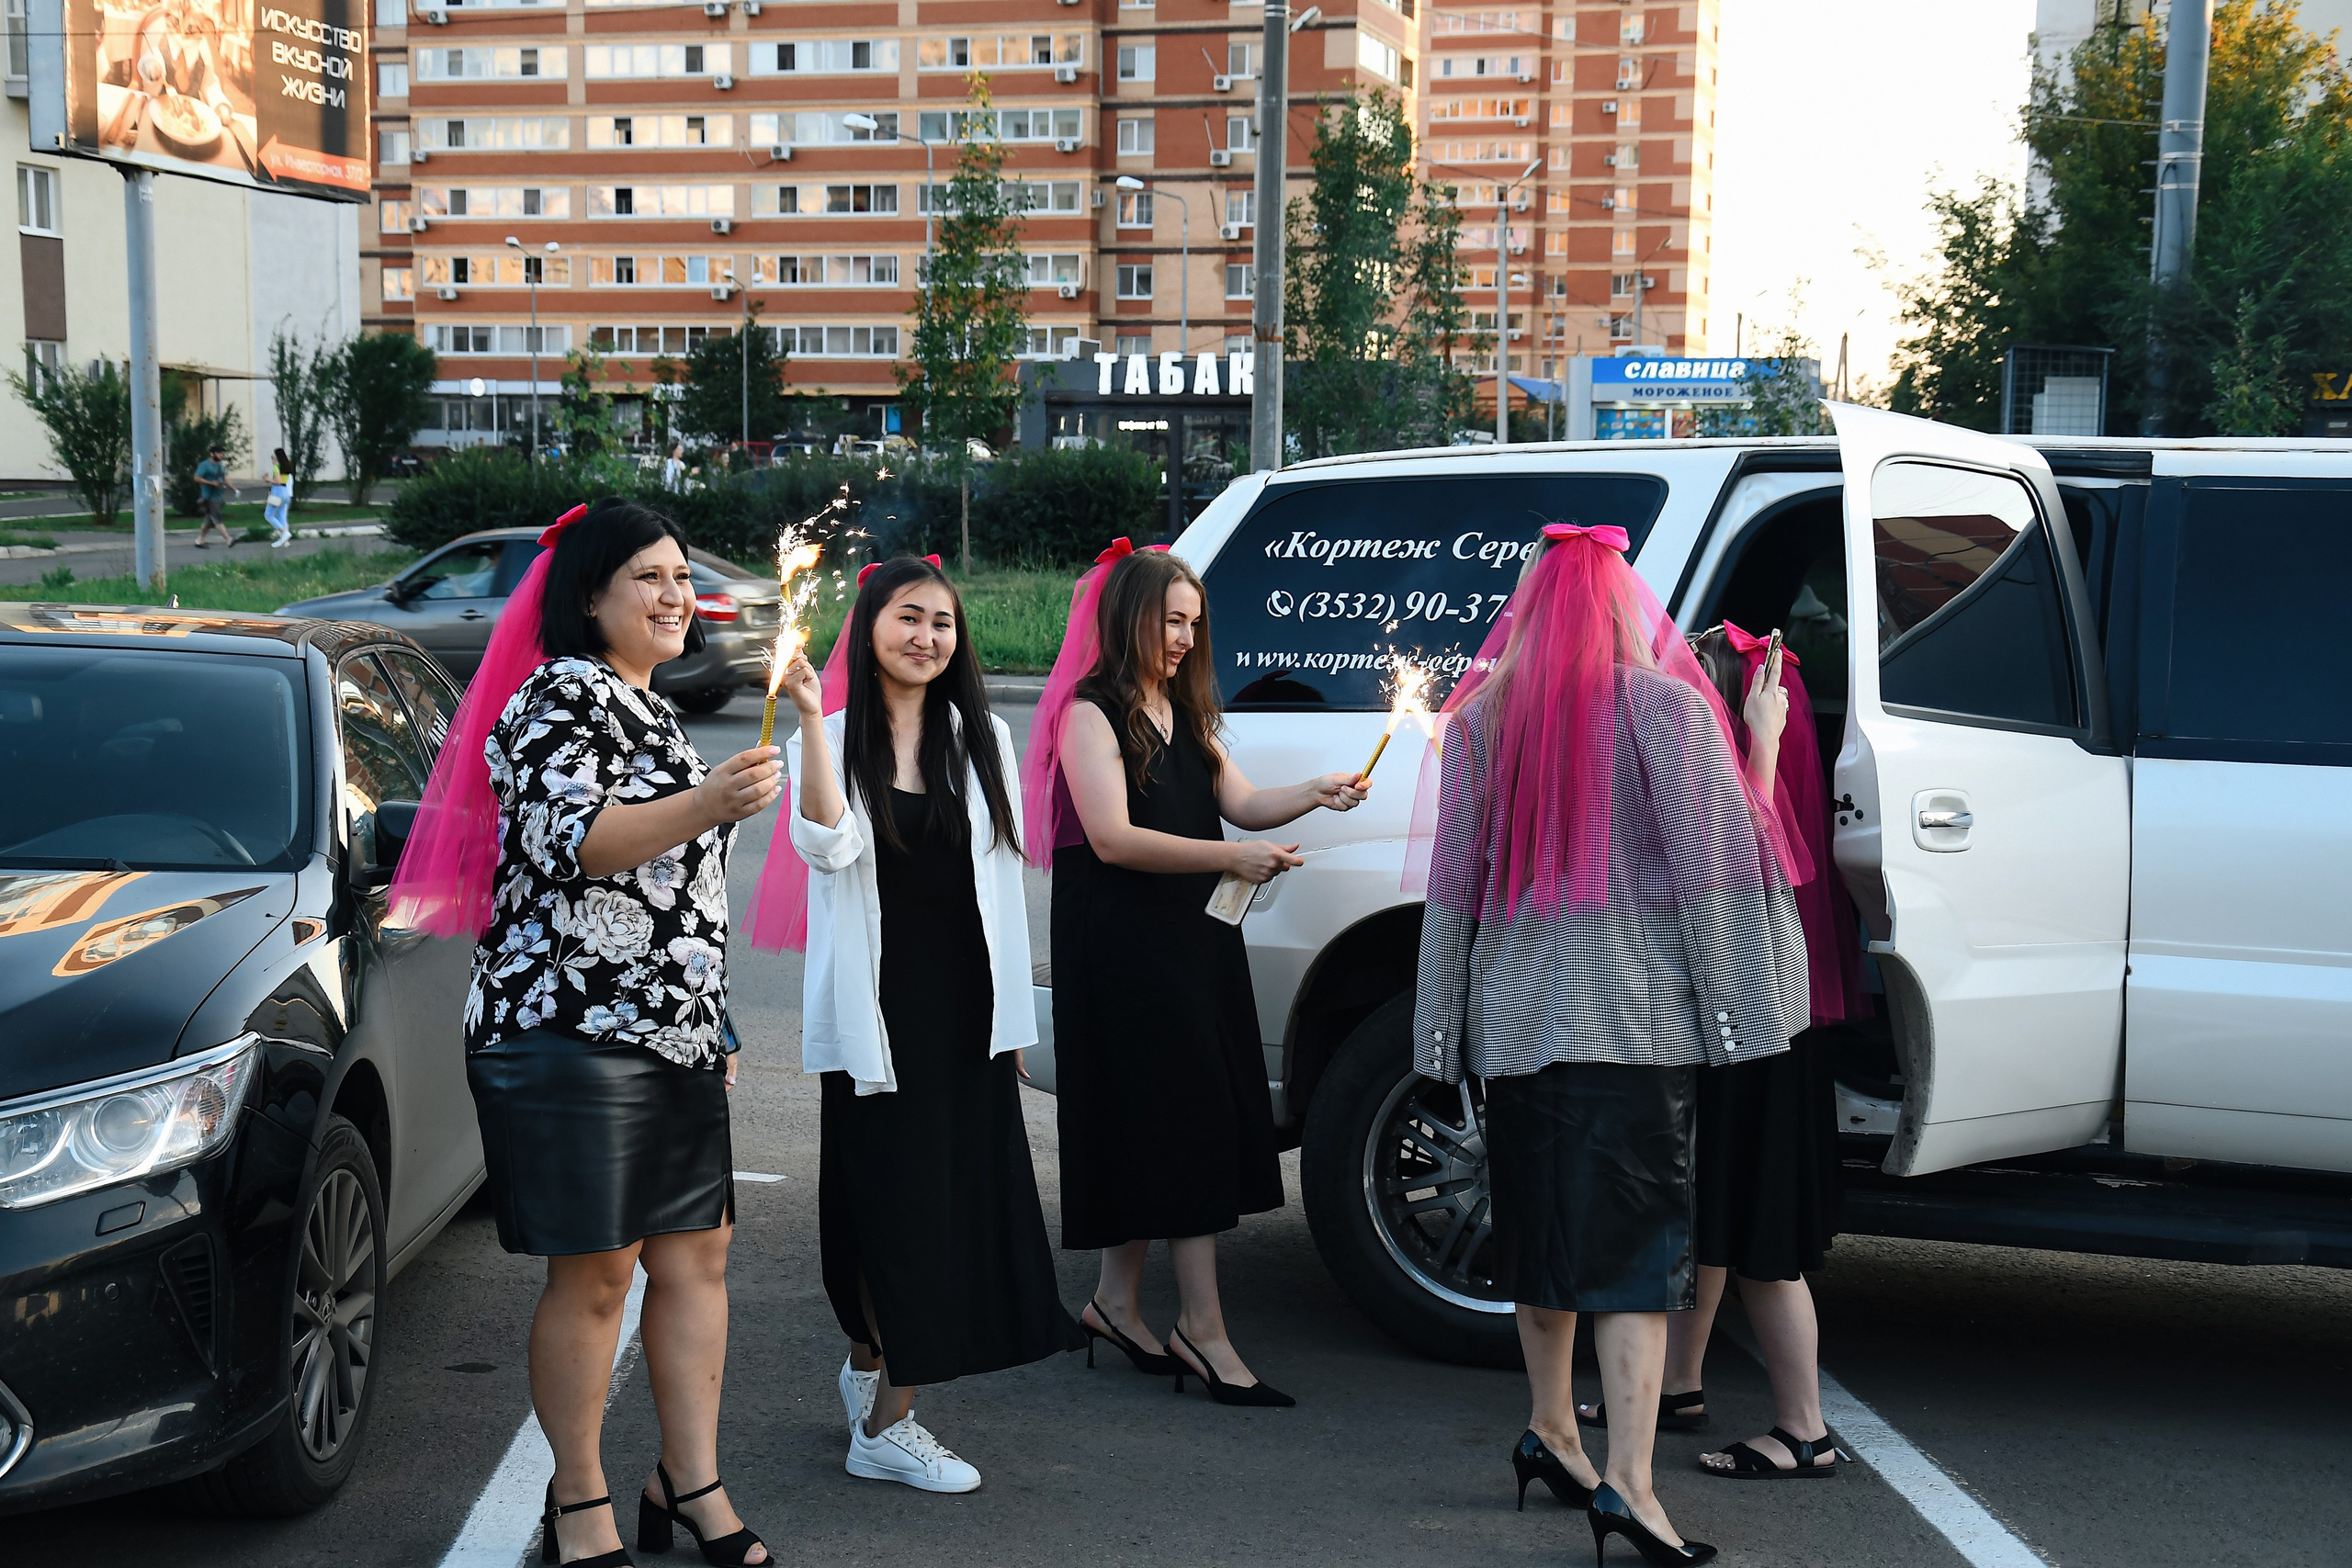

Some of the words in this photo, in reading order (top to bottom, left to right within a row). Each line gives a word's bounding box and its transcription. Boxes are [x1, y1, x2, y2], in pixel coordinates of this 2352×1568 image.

[261, 6, 362, 53] ИСКУССТВО
[272, 41, 354, 81] ВКУСНОЙ
[281, 74, 345, 109] ЖИЗНИ
[1093, 351, 1255, 396] ТАБАК
[1632, 387, 1734, 398] МОРОЖЕНОЕ
[1264, 531, 1441, 566] «Кортеж
[1298, 592, 1396, 626] (3532)
